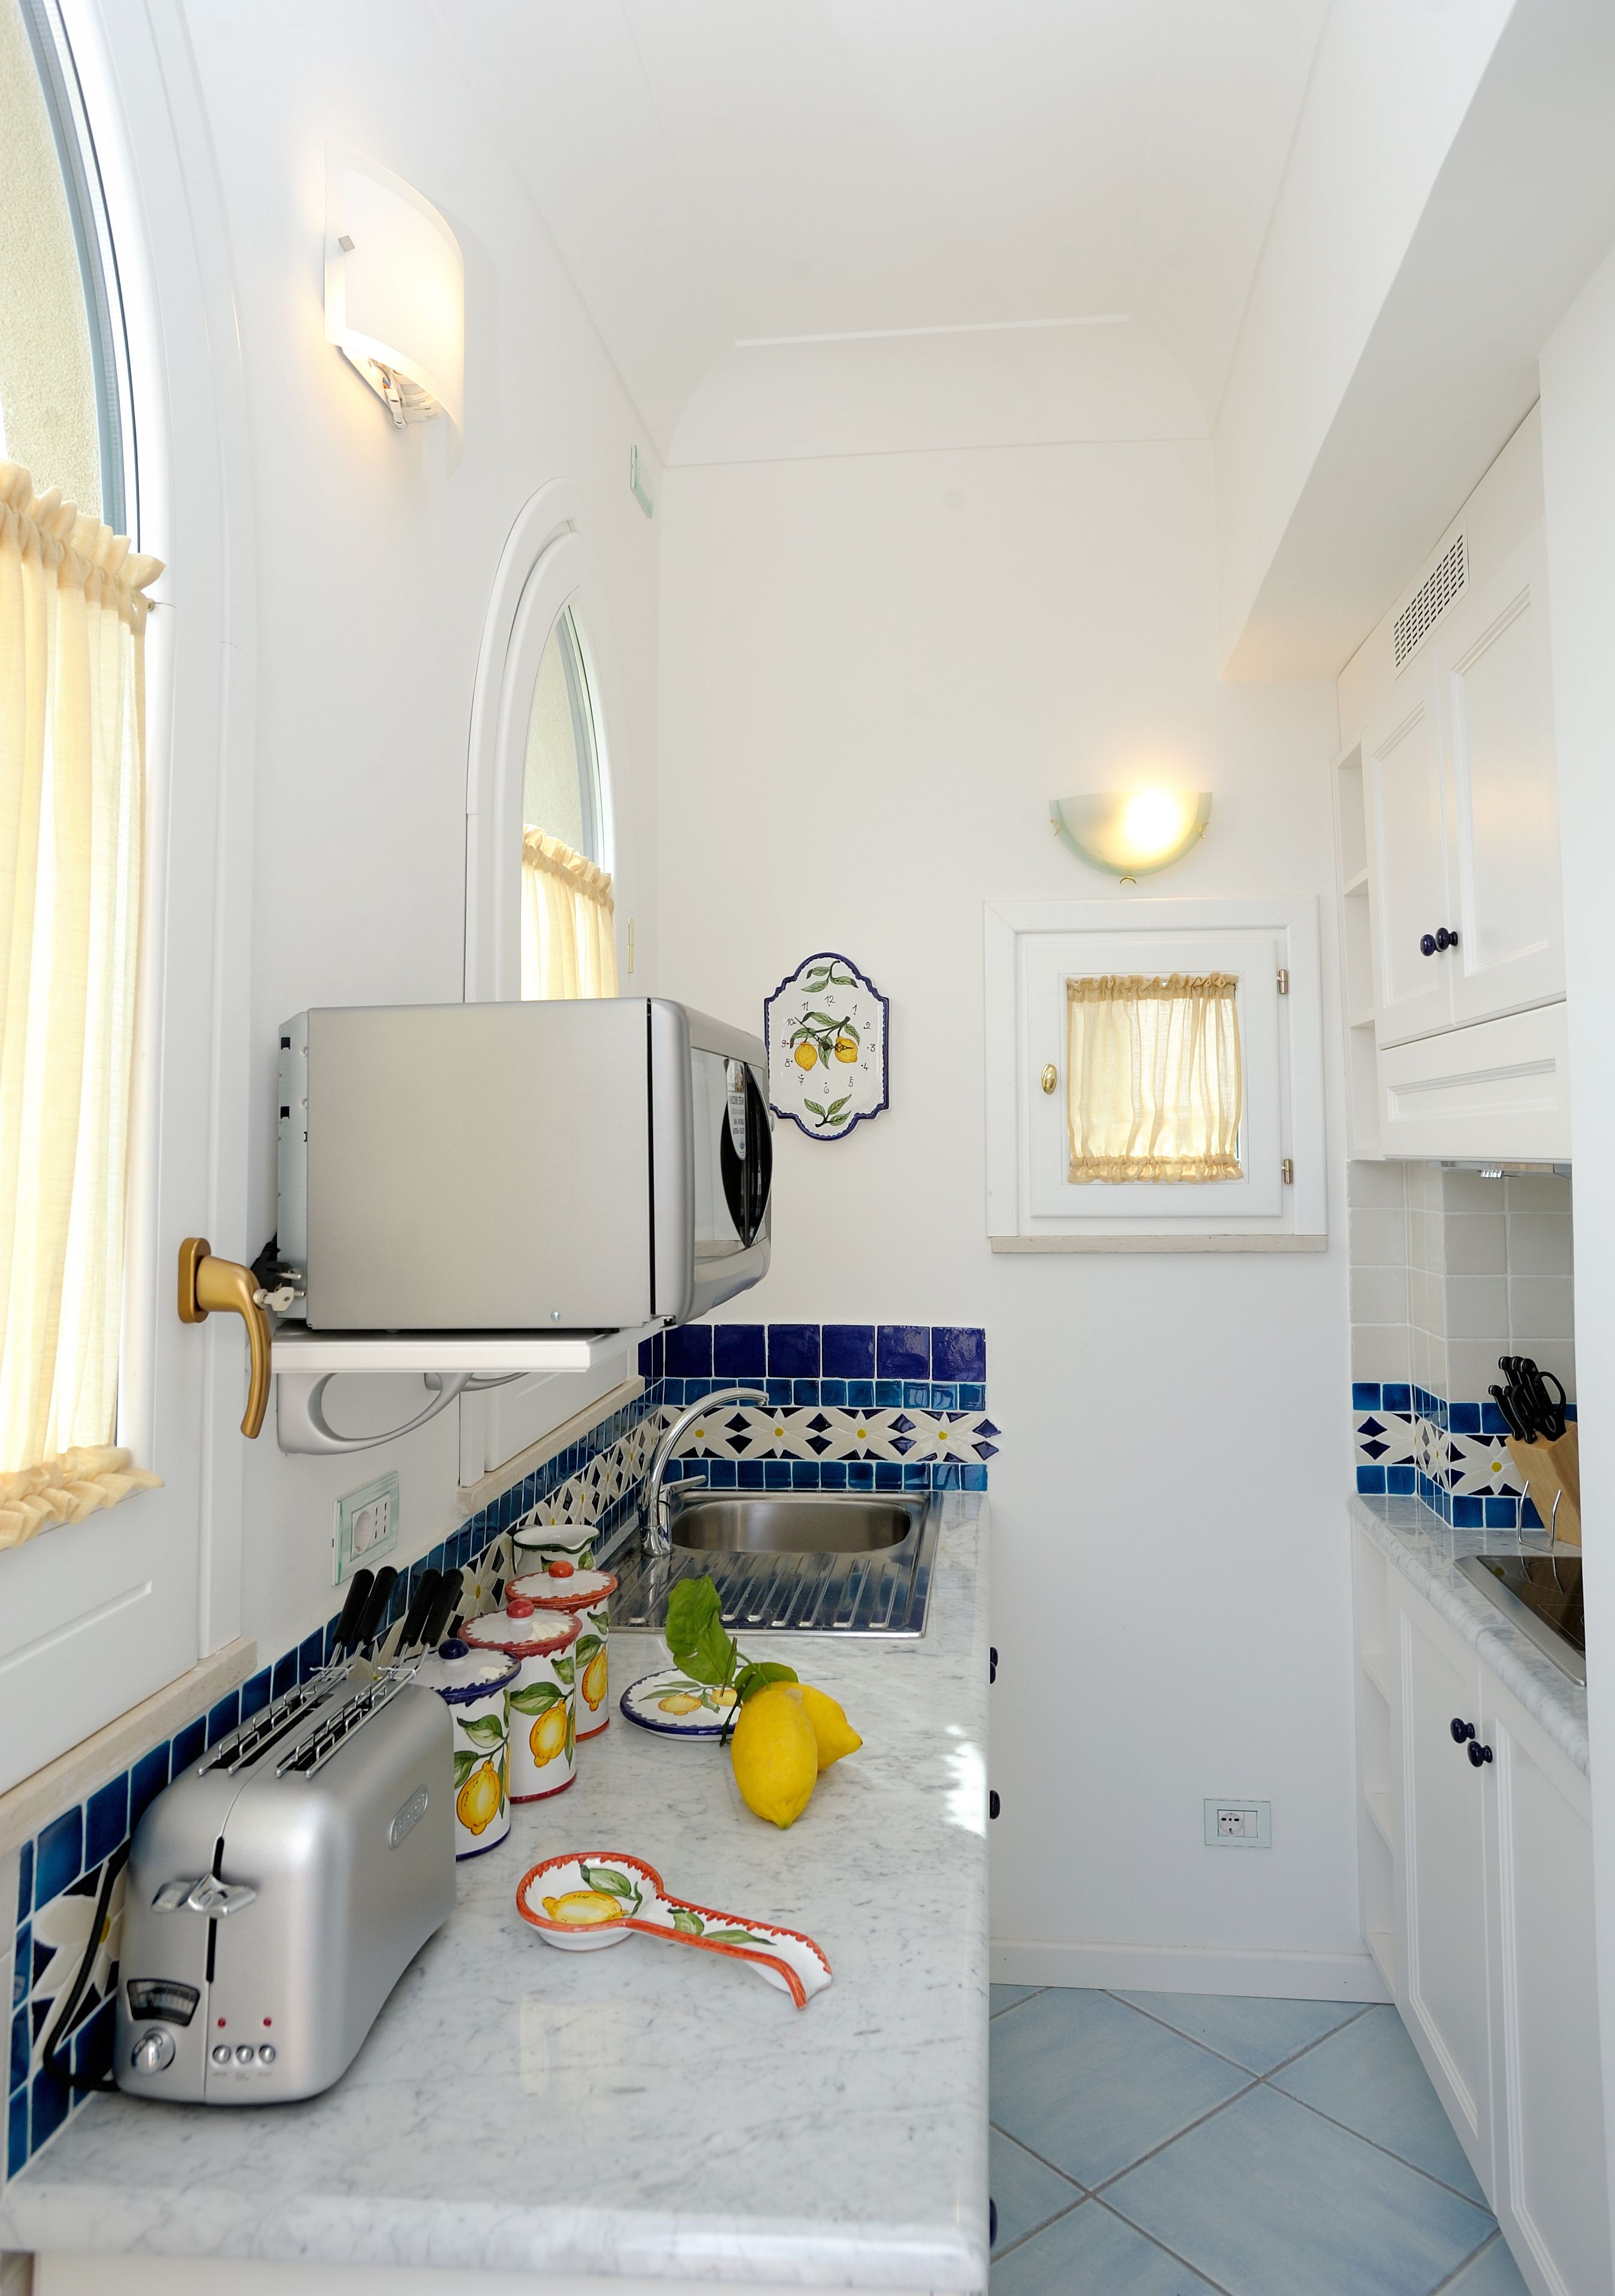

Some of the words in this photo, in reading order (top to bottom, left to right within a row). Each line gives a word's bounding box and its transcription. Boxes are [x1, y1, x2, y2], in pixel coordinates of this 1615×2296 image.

[802, 1001, 809, 1010] 11
[870, 1043, 875, 1052] 3
[785, 1058, 790, 1067] 8
[863, 1063, 868, 1071] 4
[797, 1076, 804, 1085] 7
[848, 1079, 854, 1087] 5
[823, 1085, 830, 1094] 6
